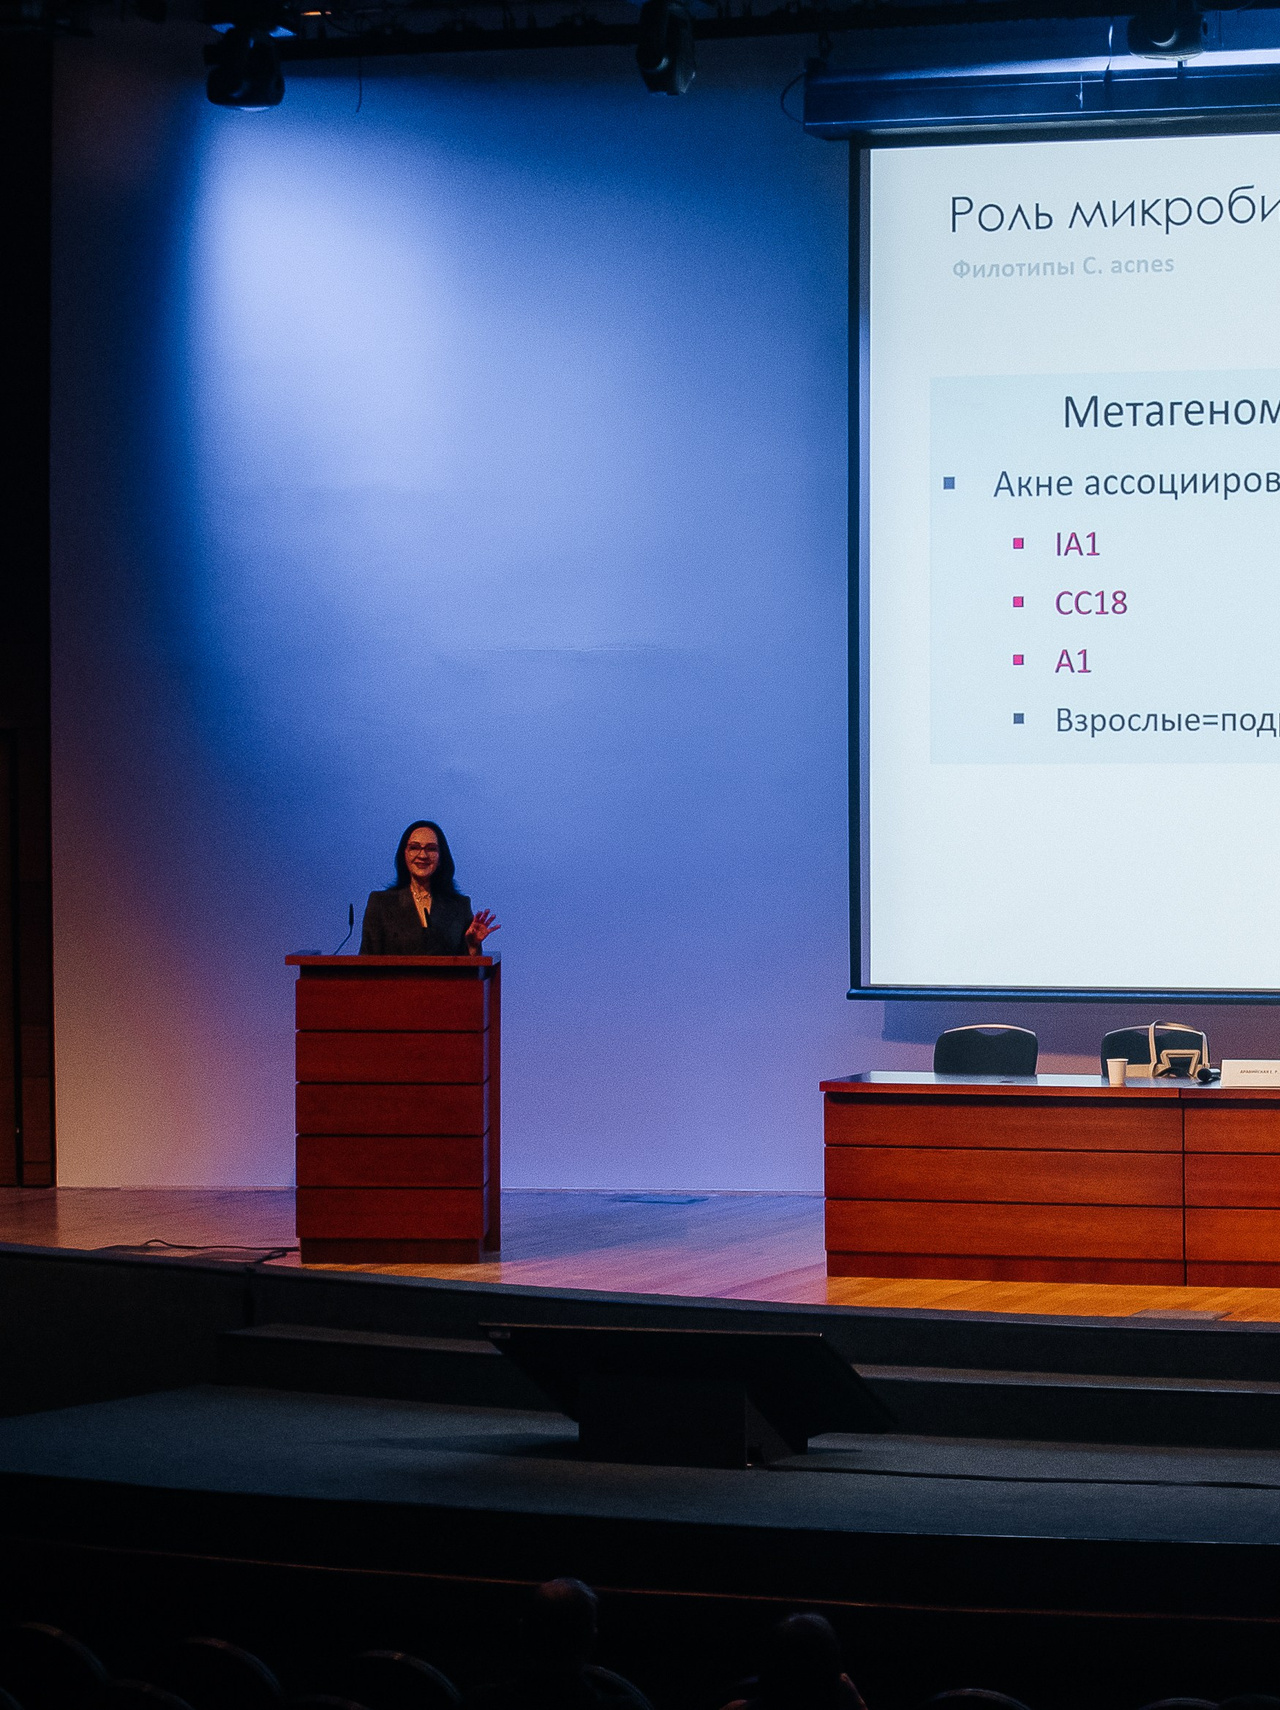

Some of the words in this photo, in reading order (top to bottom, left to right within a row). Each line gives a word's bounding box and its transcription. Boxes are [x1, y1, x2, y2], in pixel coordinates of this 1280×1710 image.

[951, 195, 1054, 233] Роль
[952, 259, 1075, 279] Филотипы
[1082, 255, 1103, 275] C.
[1110, 258, 1175, 275] acnes
[993, 470, 1074, 498] Акне
[1056, 531, 1101, 557] IA1
[1055, 590, 1128, 616] CC18
[1054, 648, 1092, 674] A1
